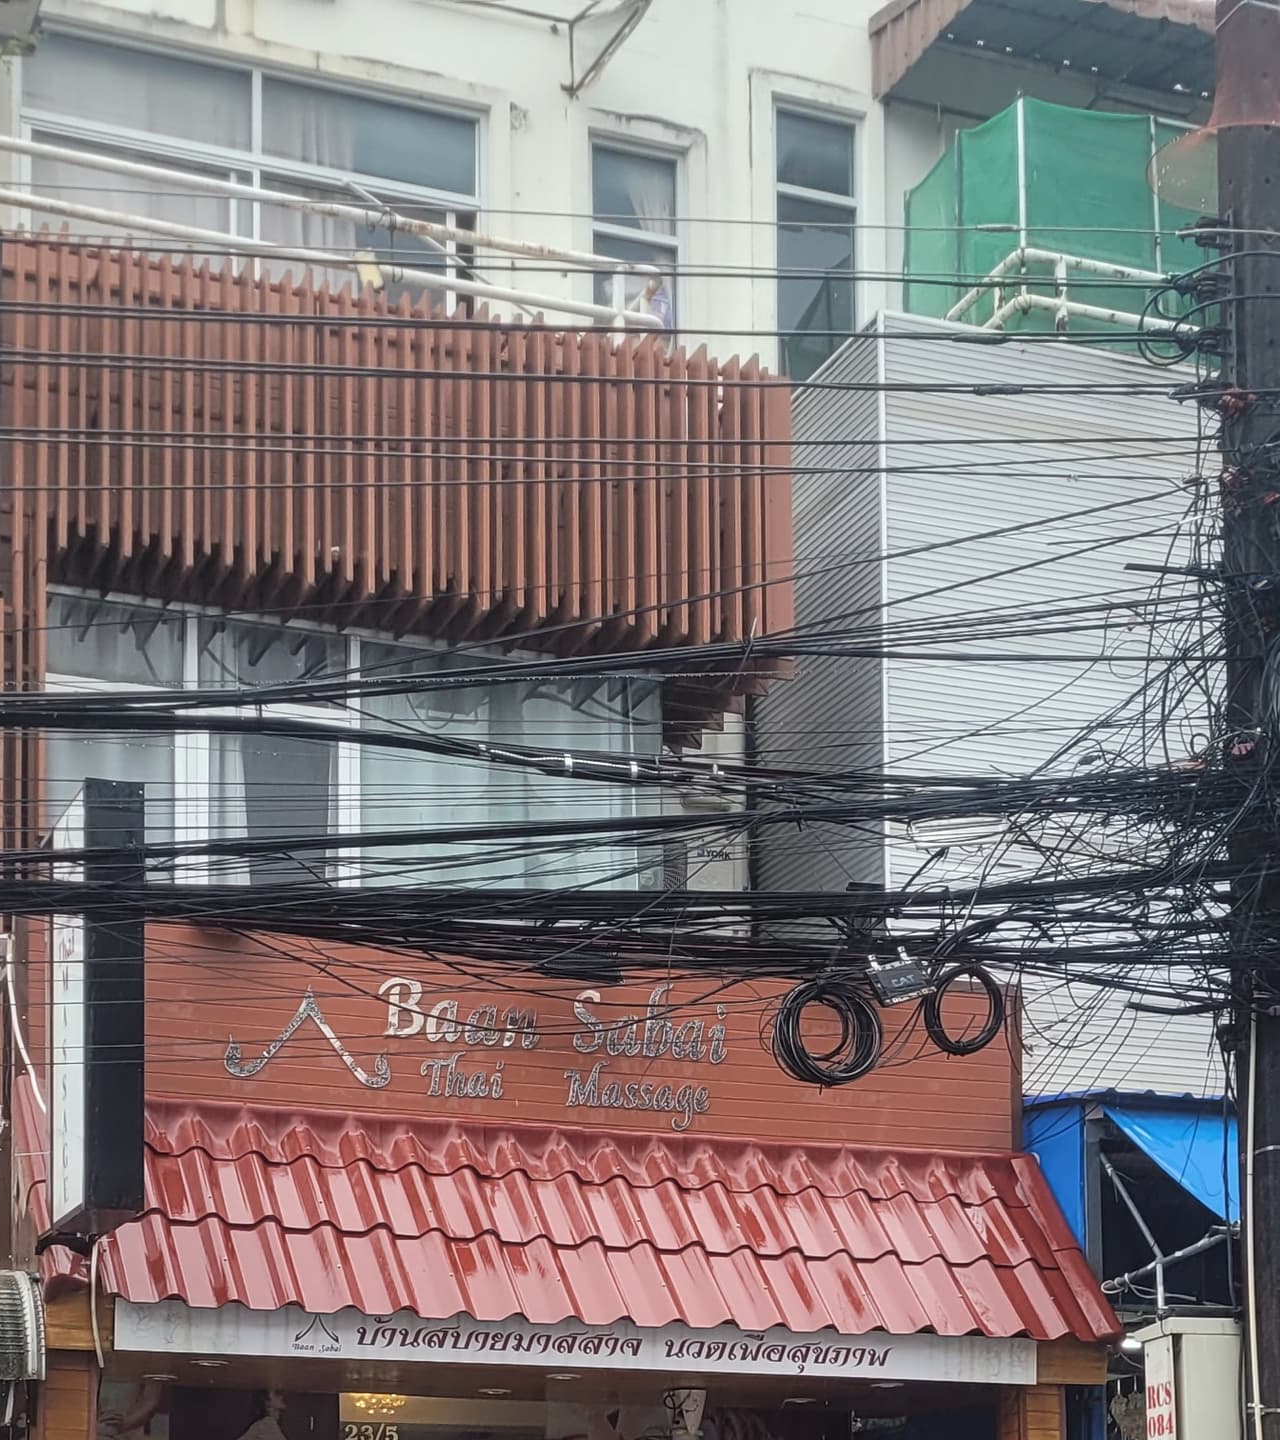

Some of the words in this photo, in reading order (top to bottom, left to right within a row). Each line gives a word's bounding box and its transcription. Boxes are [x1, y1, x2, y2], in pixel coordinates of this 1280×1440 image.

[378, 977, 542, 1049] Baan
[573, 983, 728, 1064] Sabai
[421, 1051, 505, 1099] Thai
[564, 1061, 710, 1132] Massage
[1148, 1381, 1172, 1409] RCS
[1148, 1411, 1174, 1438] 084
